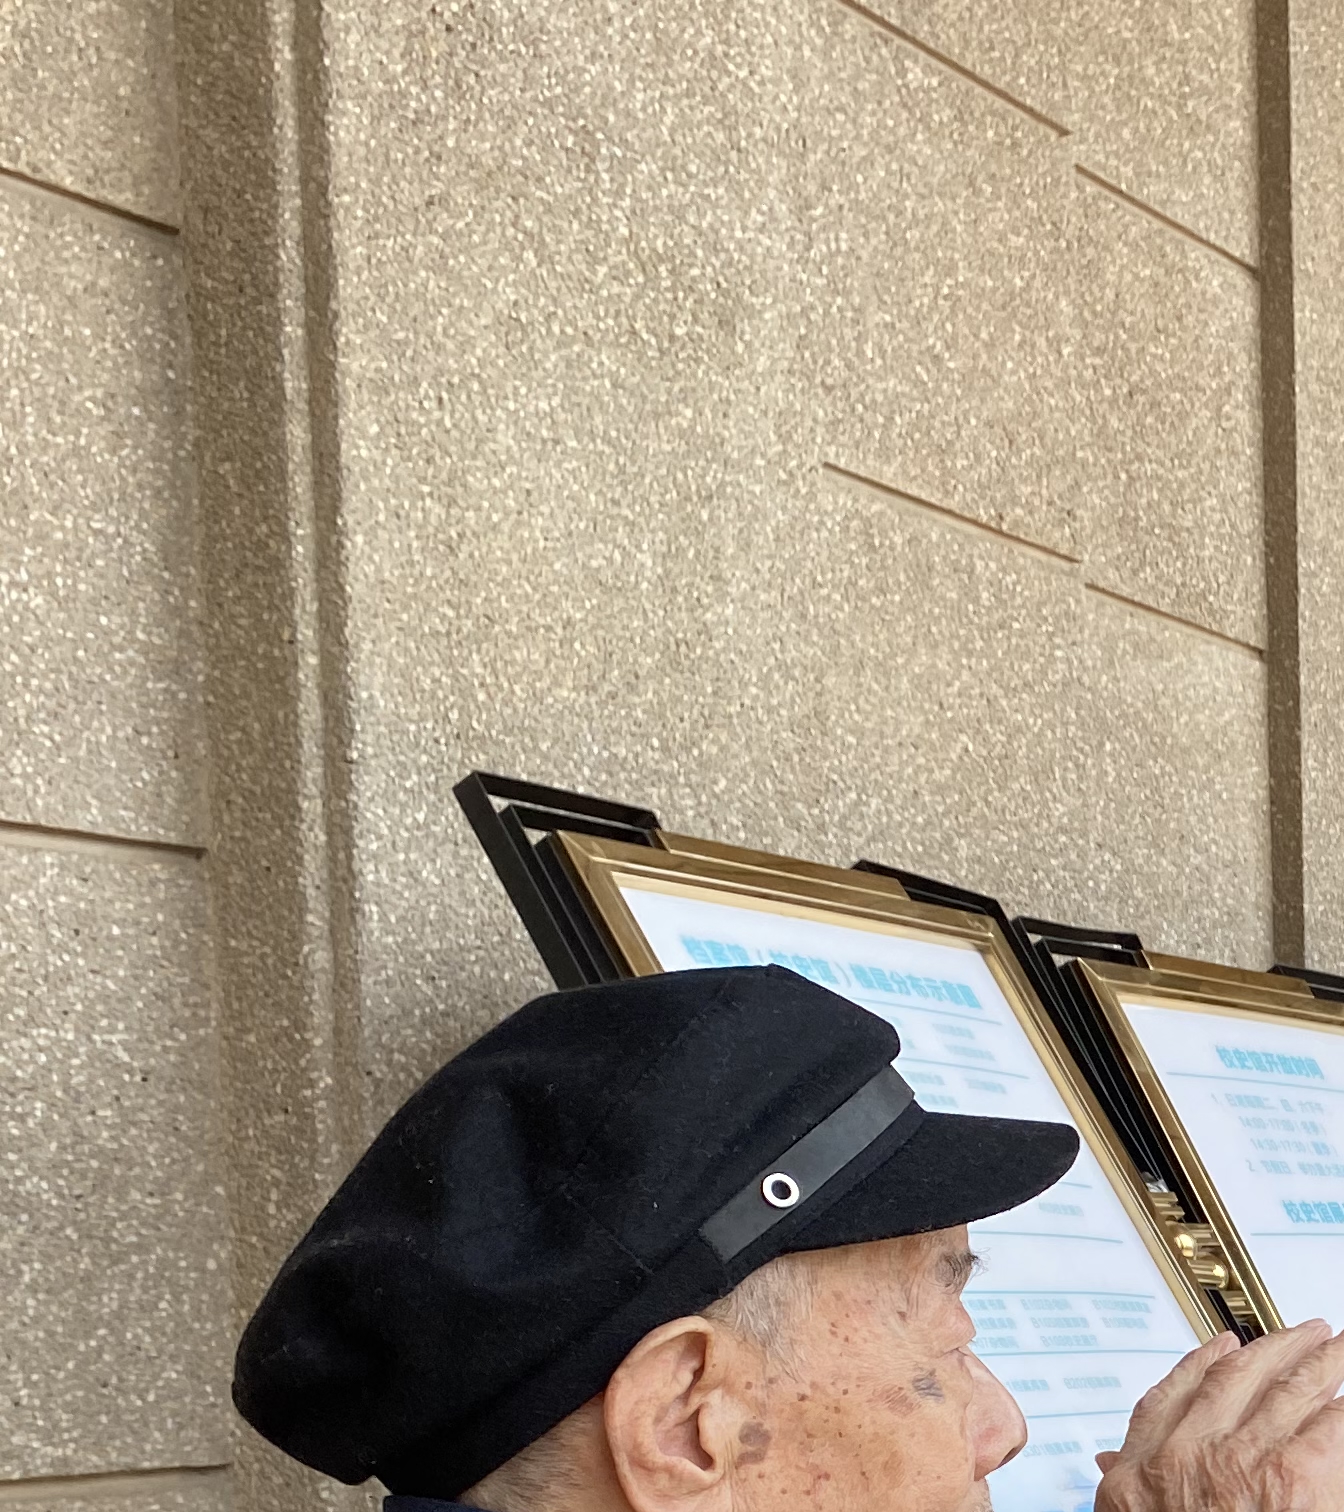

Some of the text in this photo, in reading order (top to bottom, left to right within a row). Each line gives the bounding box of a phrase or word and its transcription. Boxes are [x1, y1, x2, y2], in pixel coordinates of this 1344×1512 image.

[1216, 1047, 1324, 1078] 校史馆开放时间
